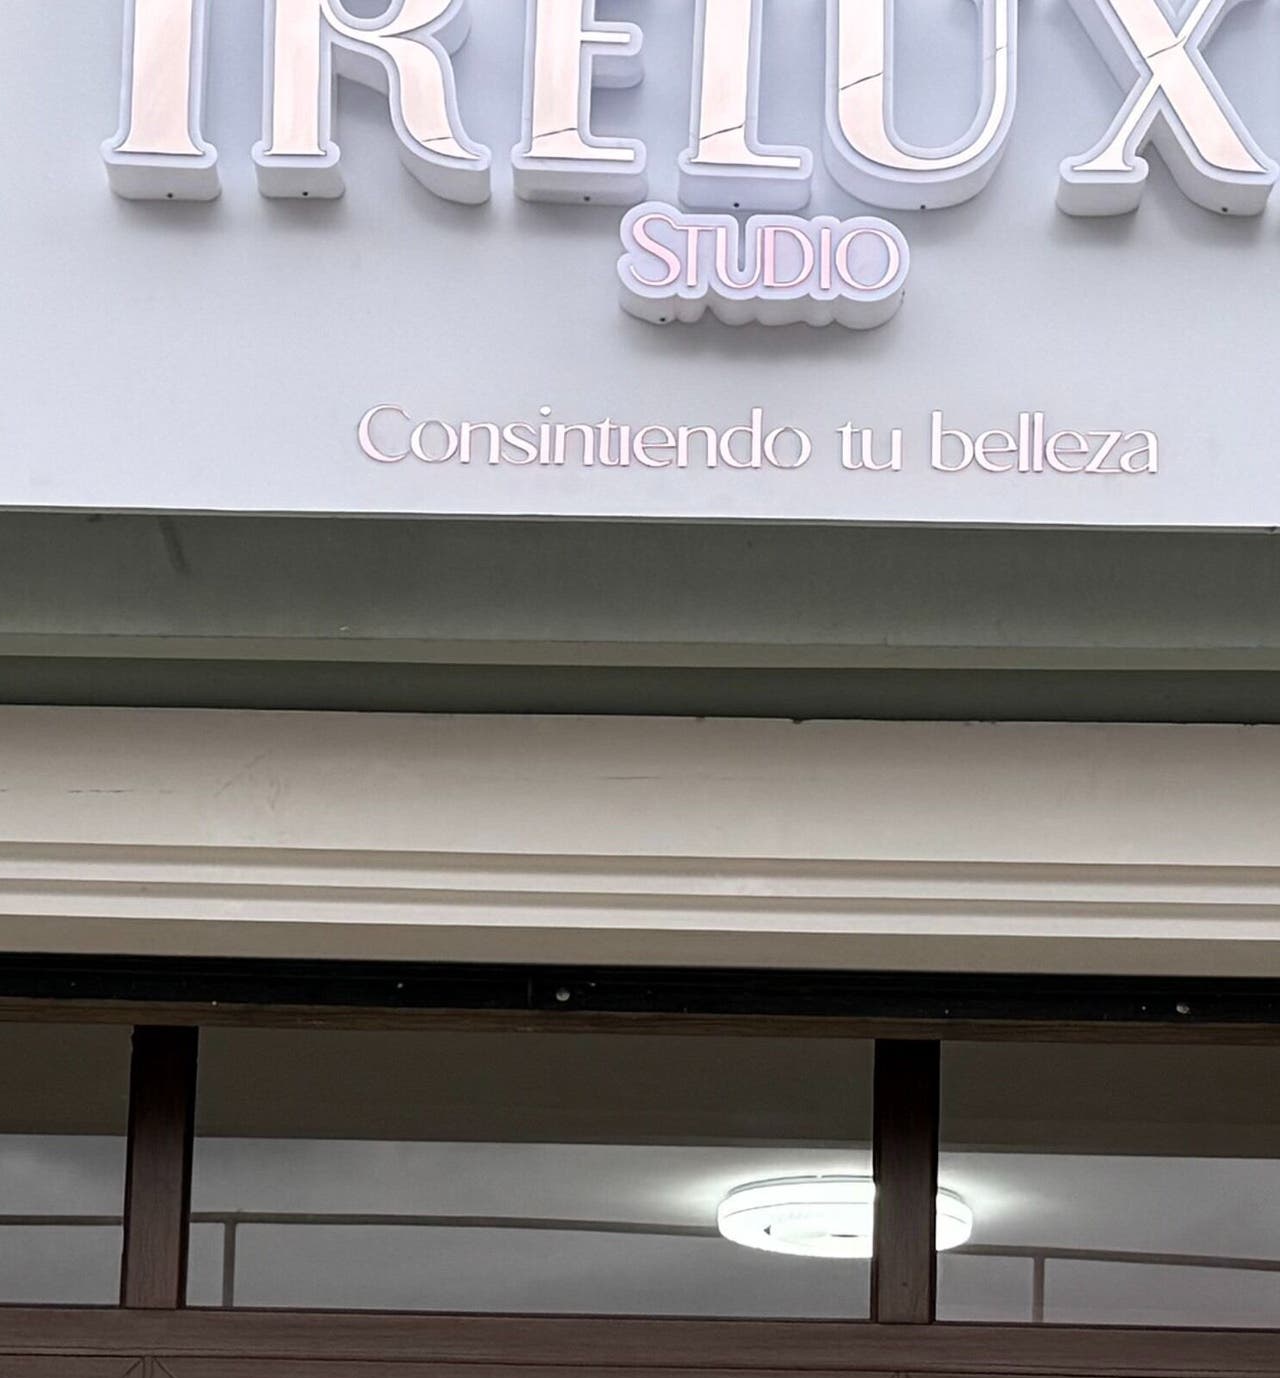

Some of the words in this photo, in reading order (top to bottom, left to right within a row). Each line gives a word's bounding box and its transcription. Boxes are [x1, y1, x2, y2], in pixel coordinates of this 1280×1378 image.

[357, 403, 813, 468] Consintiendo
[836, 420, 903, 471] tu
[930, 410, 1160, 475] belleza
